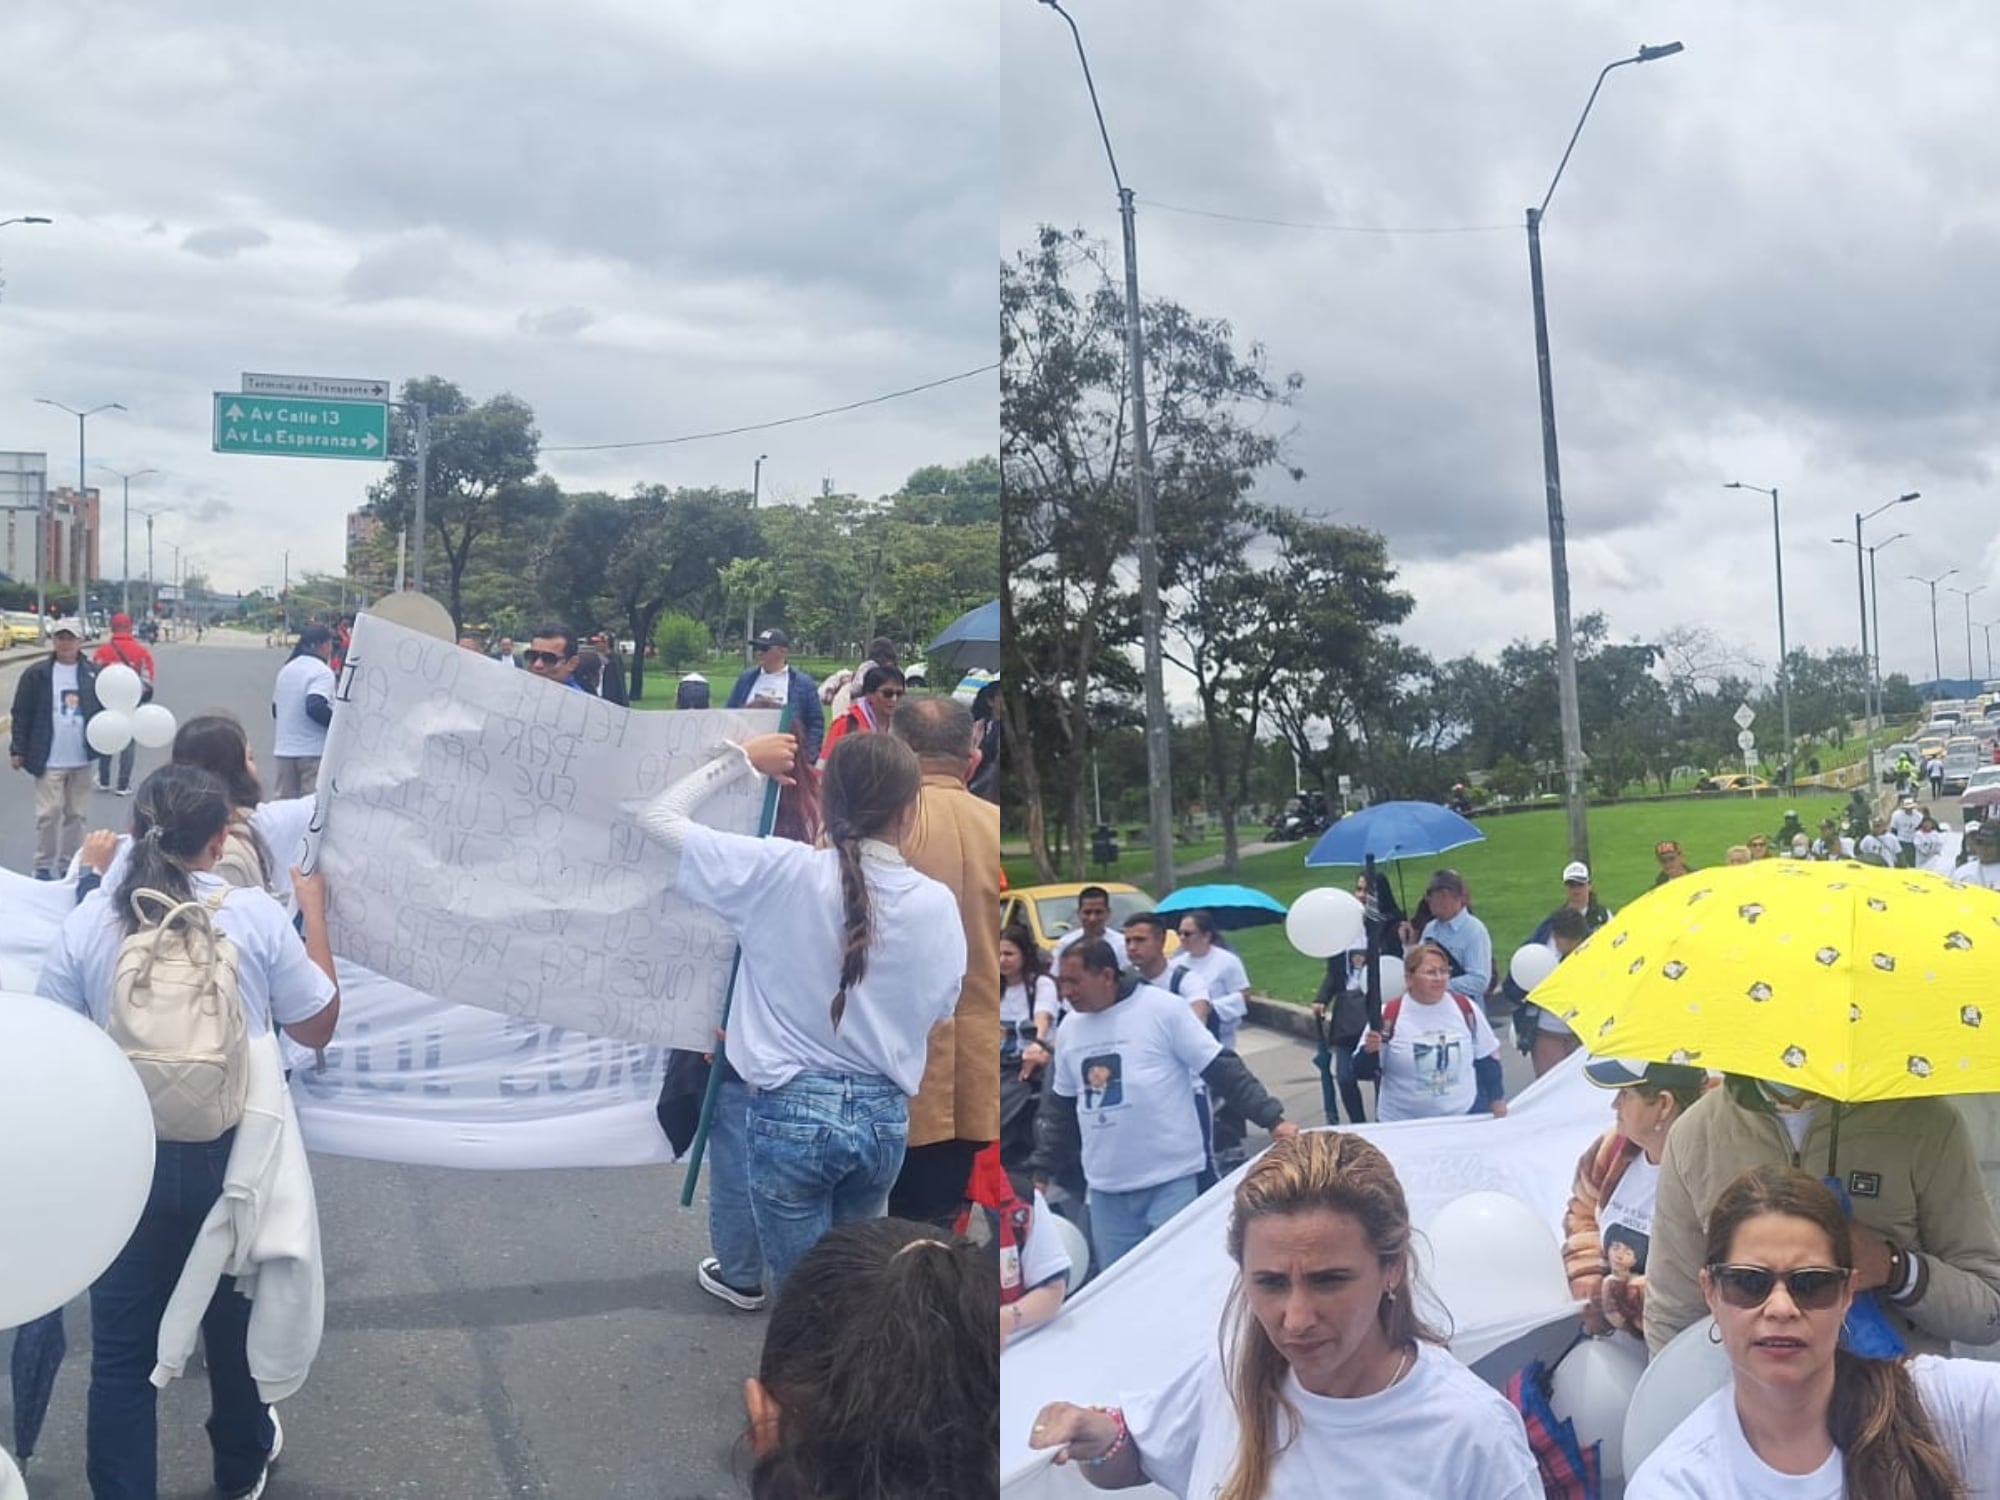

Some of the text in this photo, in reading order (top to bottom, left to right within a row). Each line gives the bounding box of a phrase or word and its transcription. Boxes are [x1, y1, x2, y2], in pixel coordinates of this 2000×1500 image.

[249, 378, 368, 396] Terminal de Transporte
[251, 408, 339, 425] Av Calle 13
[225, 427, 357, 447] Av La Esperanza
